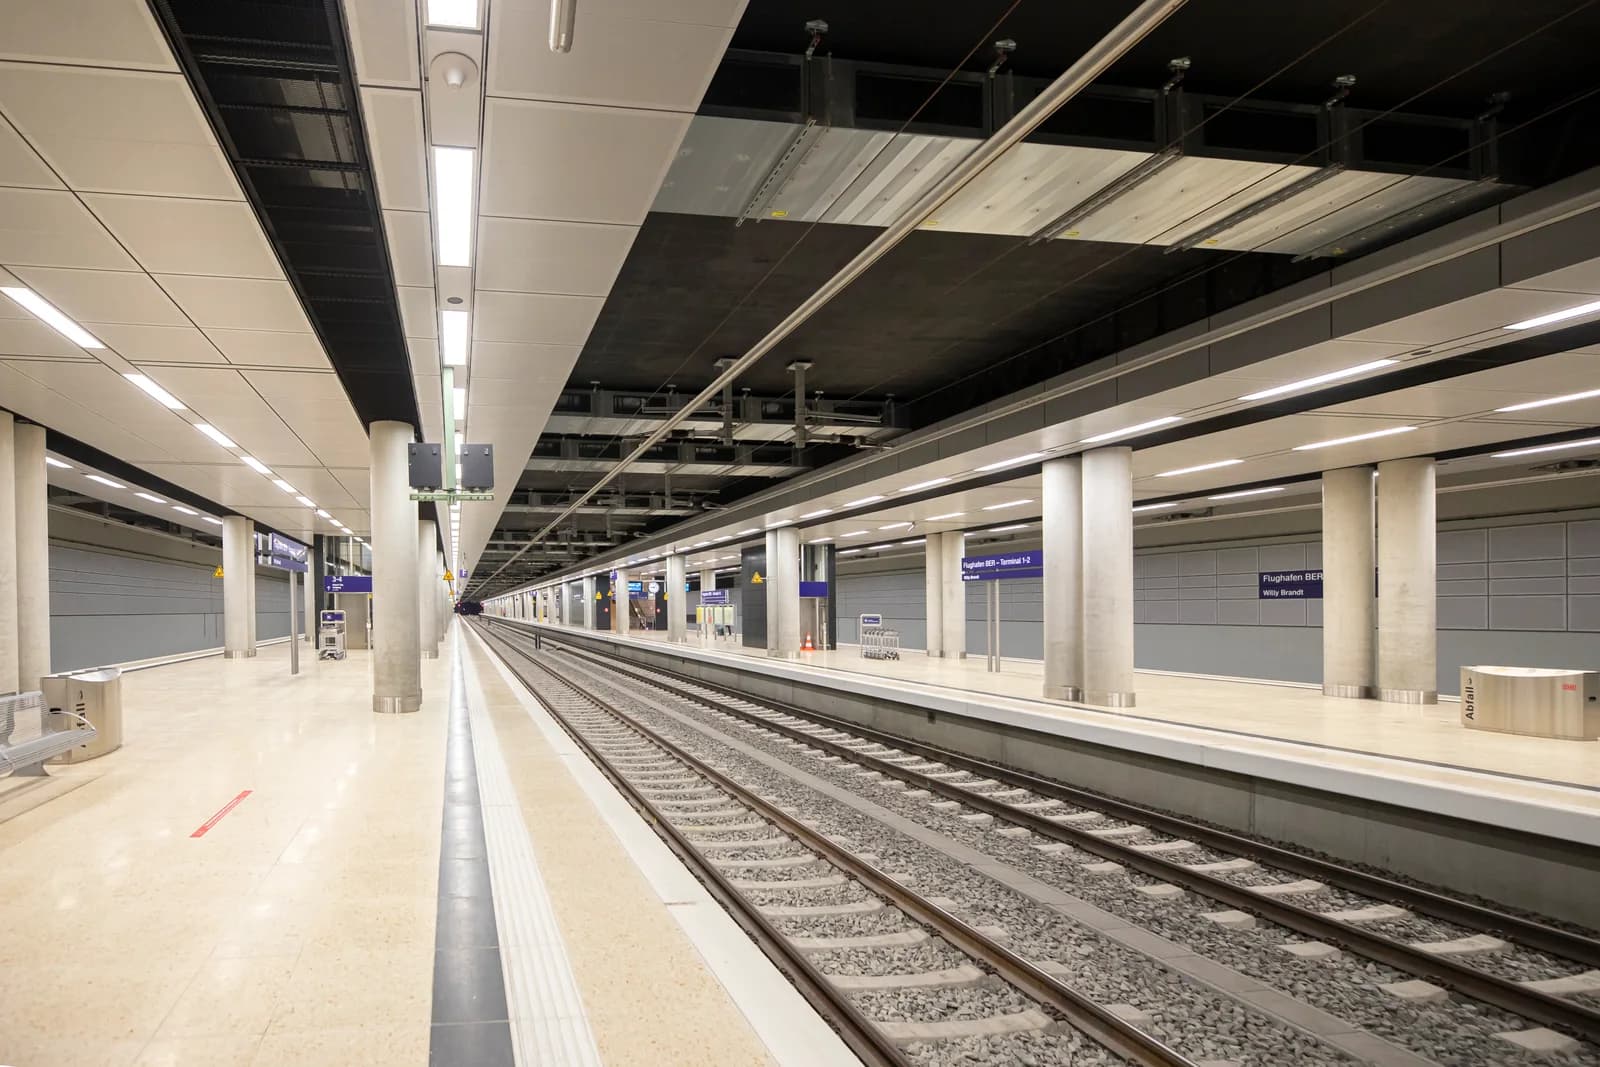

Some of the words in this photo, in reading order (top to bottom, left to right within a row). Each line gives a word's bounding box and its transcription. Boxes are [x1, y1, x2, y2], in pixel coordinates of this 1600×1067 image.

[963, 561, 984, 569] Flughafen
[986, 559, 996, 567] BER
[1022, 556, 1031, 564] 1-2
[1263, 574, 1303, 583] Flughafen
[1305, 572, 1323, 581] BER
[1263, 589, 1279, 597] Willy
[1280, 588, 1304, 596] Brandt
[1465, 686, 1474, 720] Abfall
